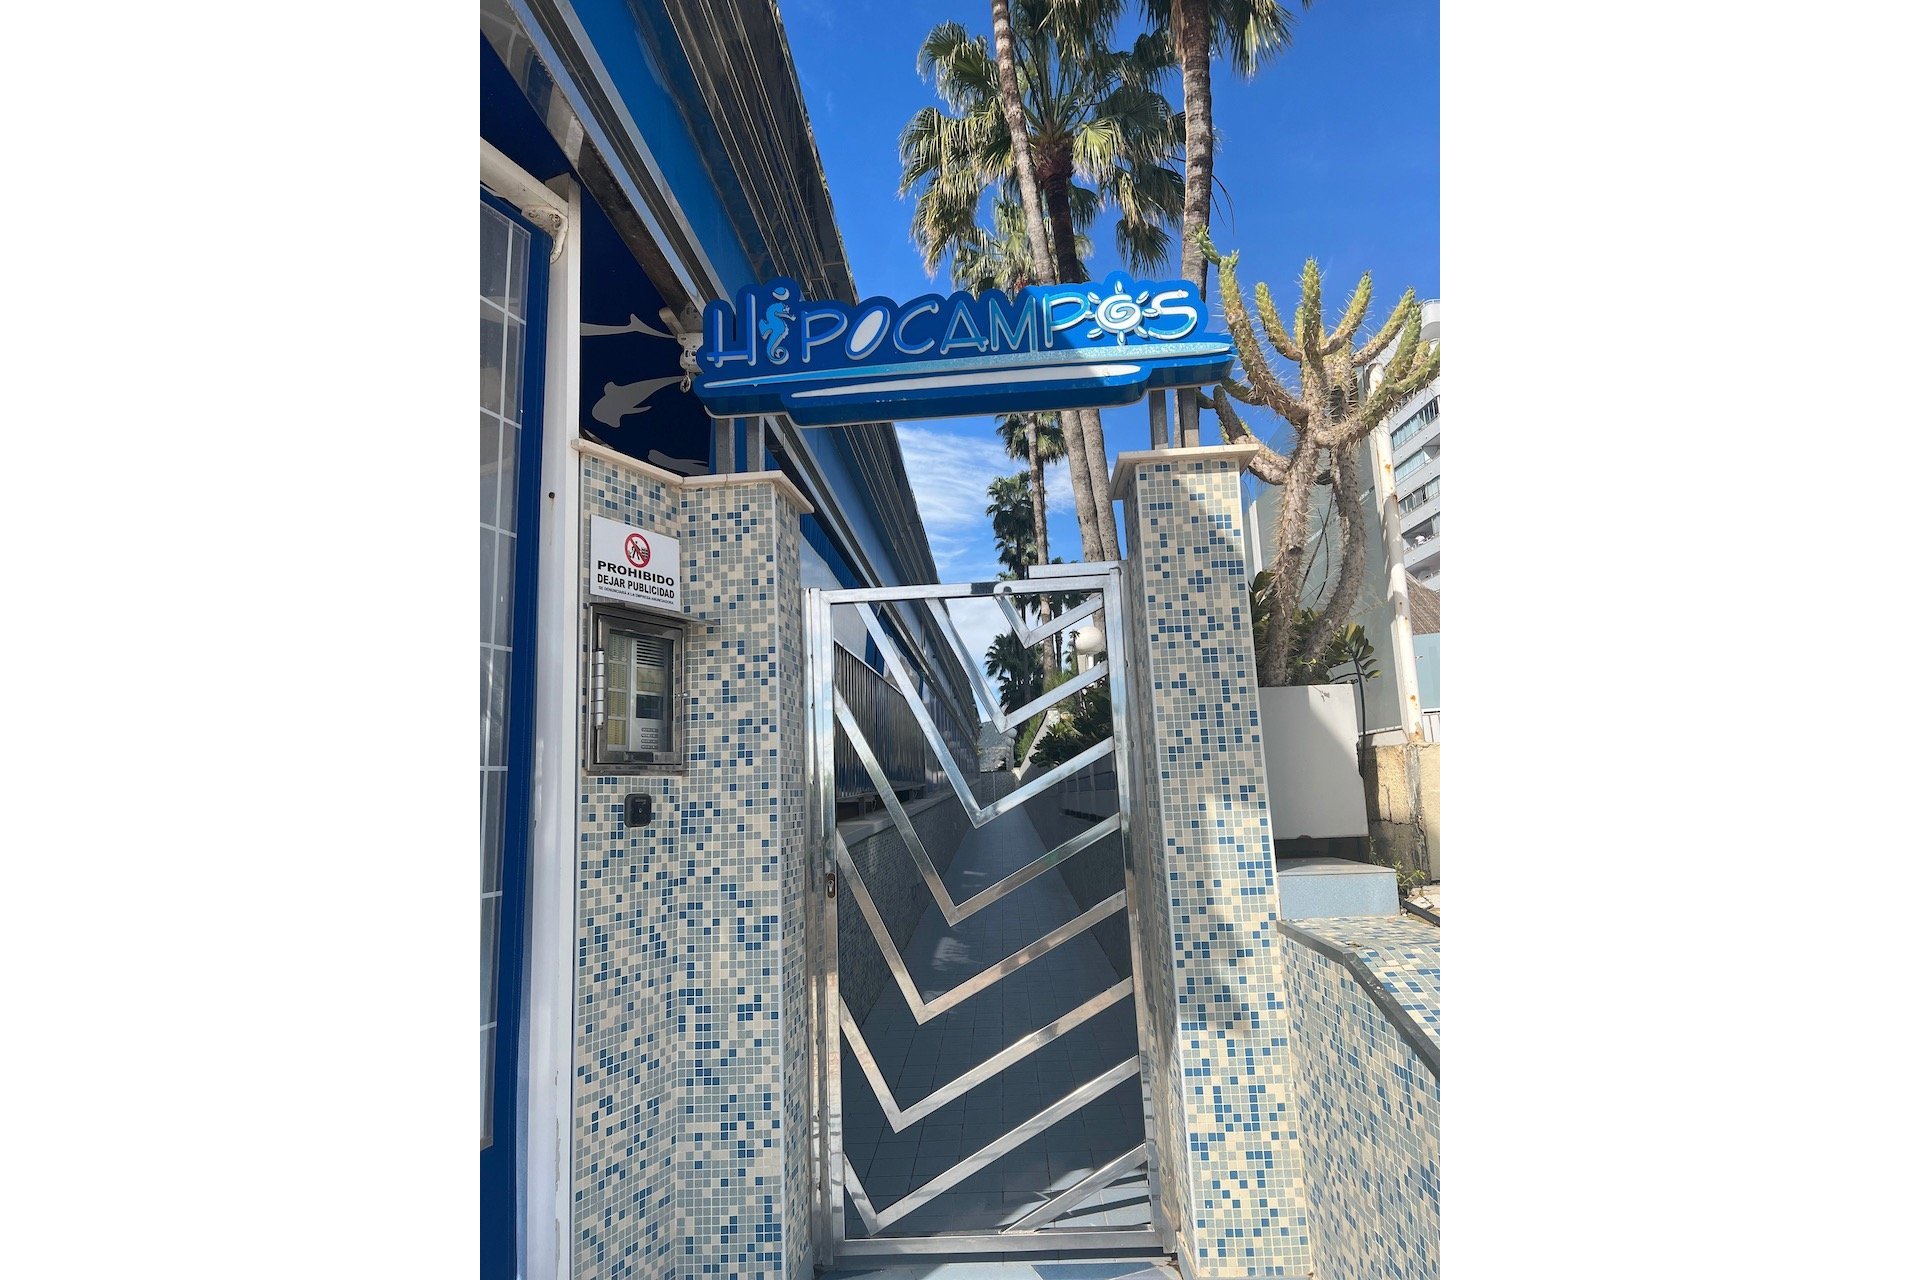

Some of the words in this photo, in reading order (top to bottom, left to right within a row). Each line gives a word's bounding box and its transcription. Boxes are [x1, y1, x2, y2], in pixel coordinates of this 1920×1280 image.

[597, 560, 674, 586] PROHIBIDO
[597, 573, 625, 588] DEJAR
[627, 580, 675, 599] PUBLICIDAD
